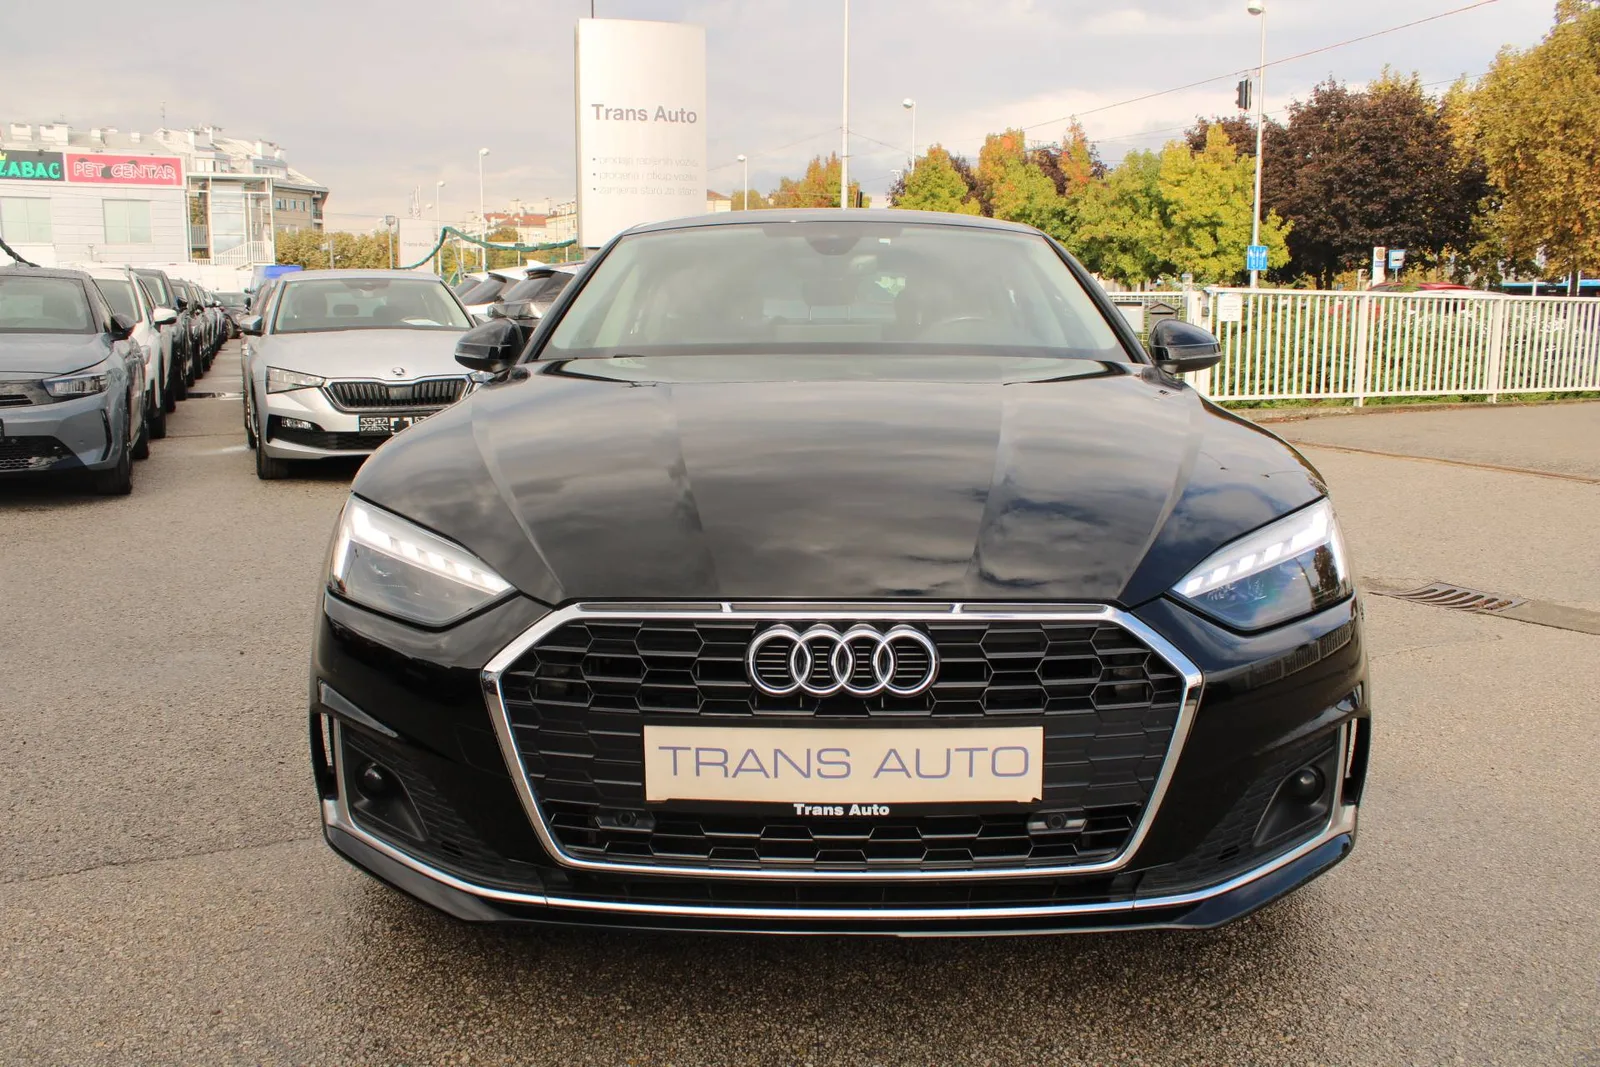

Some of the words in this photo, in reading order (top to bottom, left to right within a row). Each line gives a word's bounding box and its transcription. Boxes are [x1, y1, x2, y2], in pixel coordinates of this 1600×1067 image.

[591, 104, 648, 121] Trans
[654, 105, 697, 124] Auto
[73, 161, 105, 177] PET
[110, 162, 176, 179] CENTAR
[658, 745, 851, 779] TRANS
[873, 745, 1030, 779] AUTO
[793, 803, 844, 816] Trans
[849, 803, 890, 816] Auto
